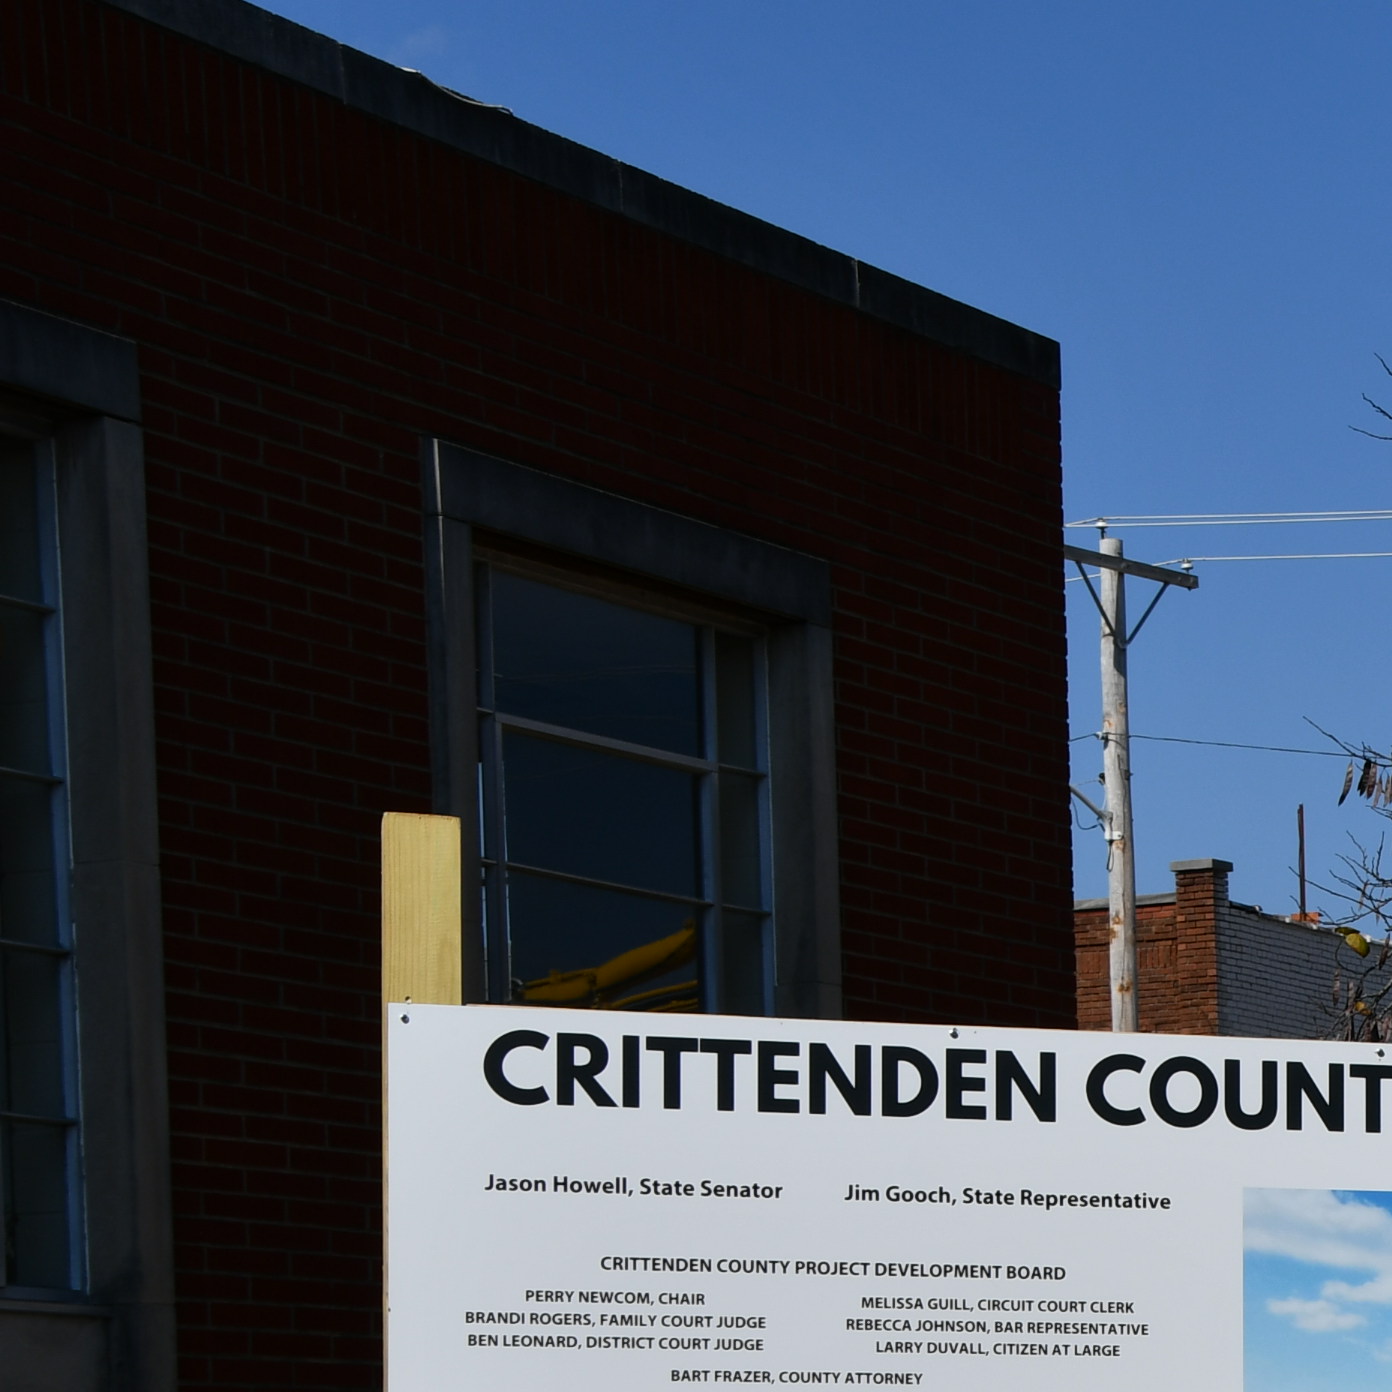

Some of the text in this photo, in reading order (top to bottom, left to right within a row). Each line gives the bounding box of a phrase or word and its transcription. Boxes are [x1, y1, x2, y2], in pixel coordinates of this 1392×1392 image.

[482, 1028, 1056, 1123] CRITTENDEN
[484, 1173, 783, 1199] Jason Howell, State Senator
[843, 1183, 1171, 1211] Jim Gooch, State Representative
[600, 1255, 1066, 1281] CRITTENDEN COUNTY PROJECT DEVELOPMENT BOARD
[525, 1289, 705, 1306] PERRY NEWCOM, CHAIR
[861, 1296, 1135, 1314] MELISSA GUILL, CIRCUIT COURT CLERK
[465, 1310, 766, 1329] BRANDI ROGERS, FAMILY COURT JUDGE
[846, 1318, 1149, 1336] REBECCA JOHNSON, BAR REPRESENTATIVE
[467, 1333, 764, 1351] BEN LEONARD, DISTRICT COURT JUDGE
[875, 1340, 1121, 1357] LARRY DUVALL, CITIZEN AT LARGE
[670, 1369, 923, 1385] BART FRAZER, COUNTY ATTORNEY
